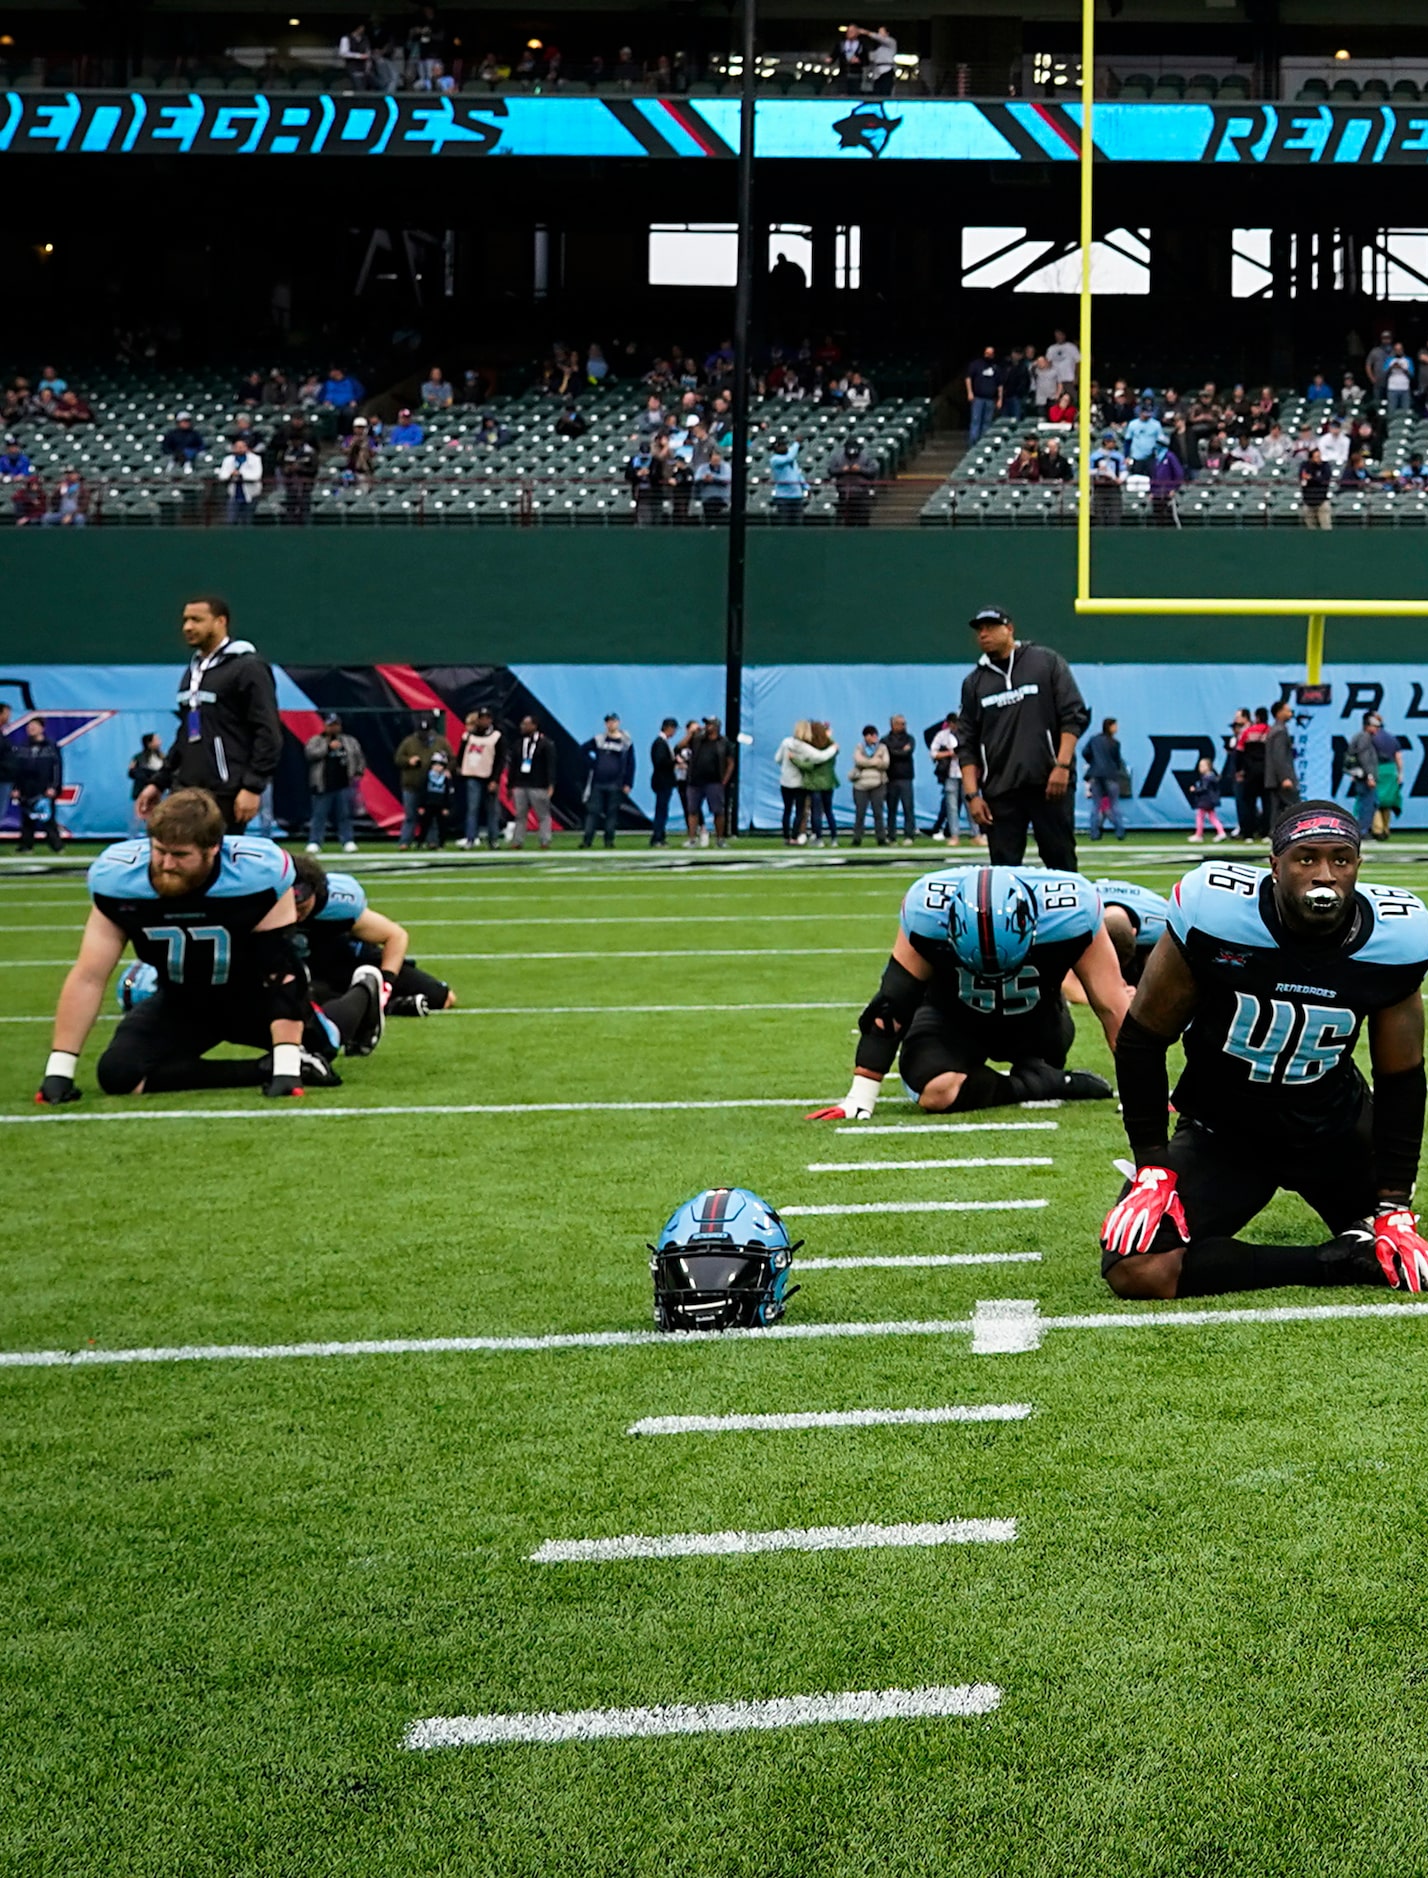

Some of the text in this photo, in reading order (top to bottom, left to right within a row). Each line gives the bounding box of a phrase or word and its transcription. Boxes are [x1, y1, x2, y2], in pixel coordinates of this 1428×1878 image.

[0, 93, 508, 154] ENEGADES
[1044, 880, 1077, 910] 65
[1369, 887, 1421, 918] 46
[142, 926, 231, 985] 77
[1275, 982, 1337, 999] RENEGADES
[1222, 991, 1357, 1085] 46
